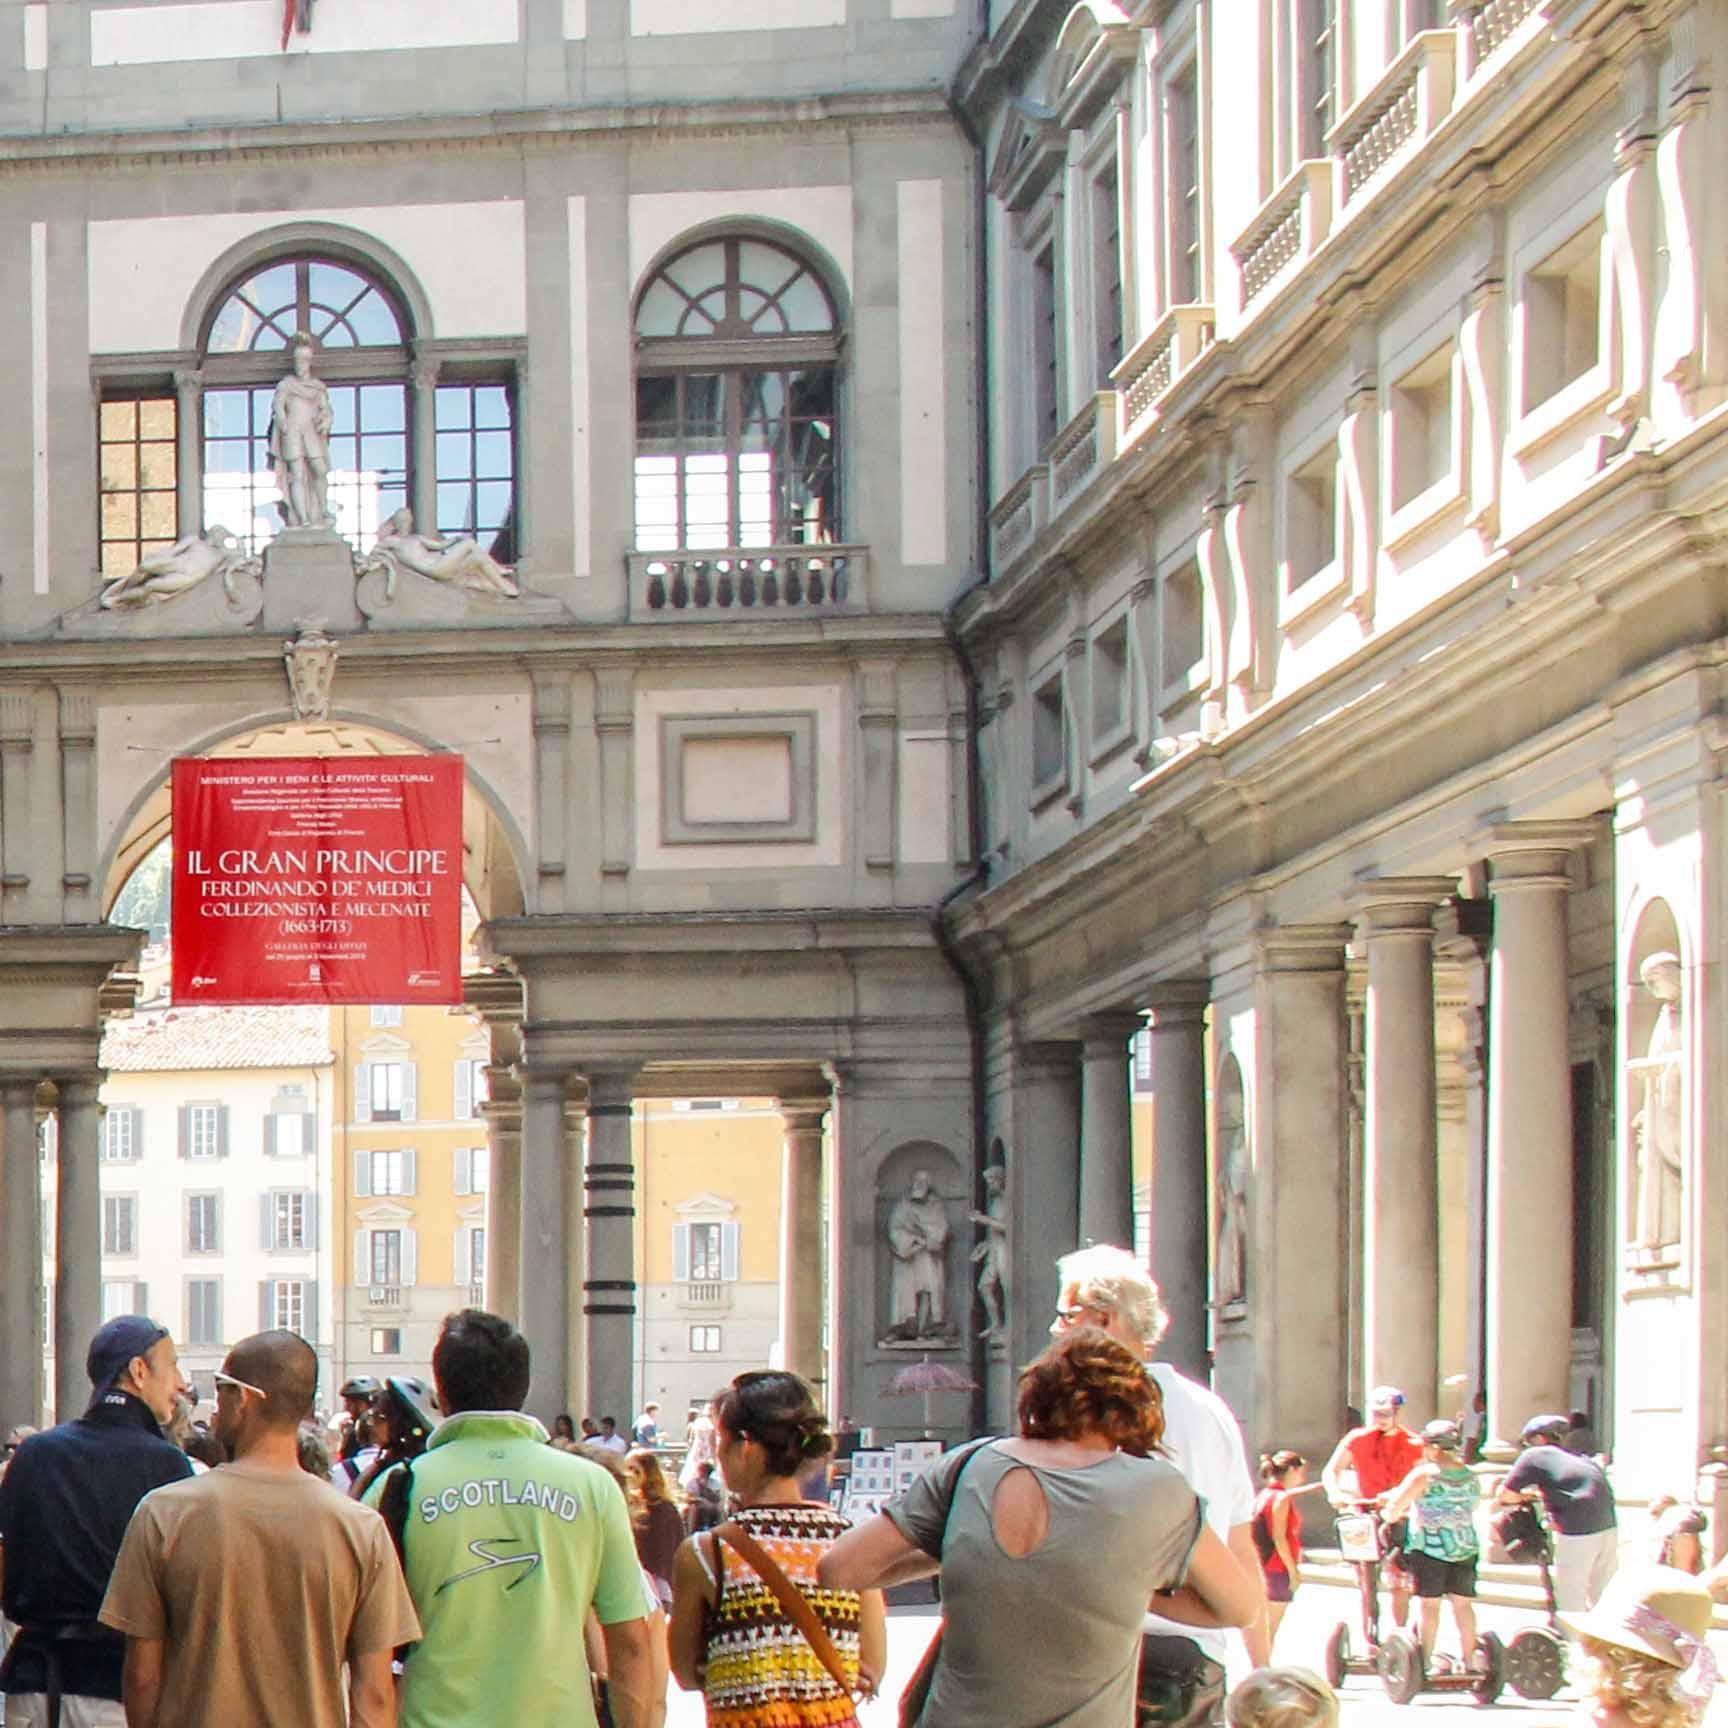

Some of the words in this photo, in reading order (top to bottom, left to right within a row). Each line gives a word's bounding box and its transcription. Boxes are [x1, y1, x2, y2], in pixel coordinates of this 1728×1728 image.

[256, 775, 277, 785] PER
[380, 774, 434, 783] CULTURALI
[187, 850, 212, 875] IL
[218, 849, 307, 875] GRAN
[316, 849, 449, 875] PRINCIPE
[201, 880, 328, 897] FERDINANDO
[366, 880, 432, 897] MEDICI
[200, 902, 326, 917] COLLEZIONISTA
[331, 902, 341, 917] E
[345, 902, 432, 917] MECENATE
[420, 1479, 579, 1523] SCOTLAND
